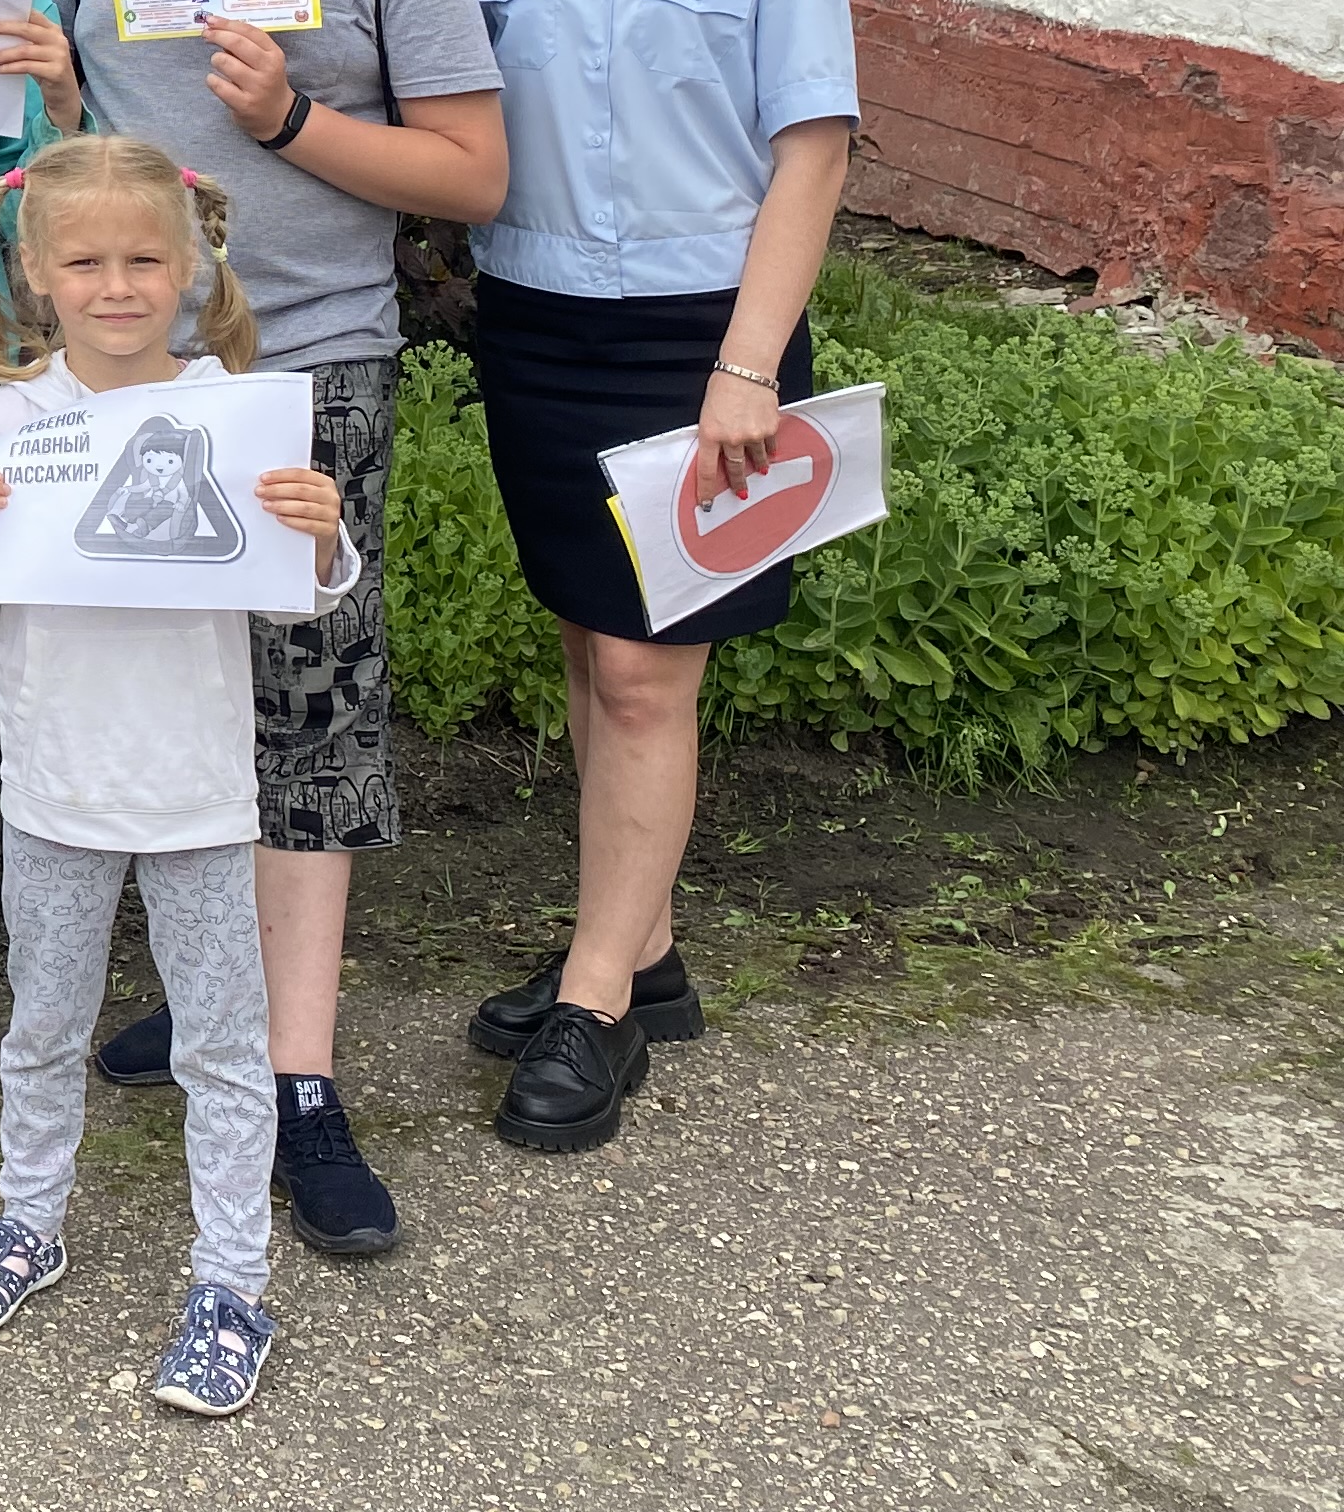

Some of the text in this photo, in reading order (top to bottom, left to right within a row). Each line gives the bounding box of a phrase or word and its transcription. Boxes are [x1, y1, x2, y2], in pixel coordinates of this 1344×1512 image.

[9, 431, 91, 458] ГЛАВНЫЙ
[2, 462, 99, 486] ПАССАЖИР!
[295, 1080, 321, 1094] SAYT
